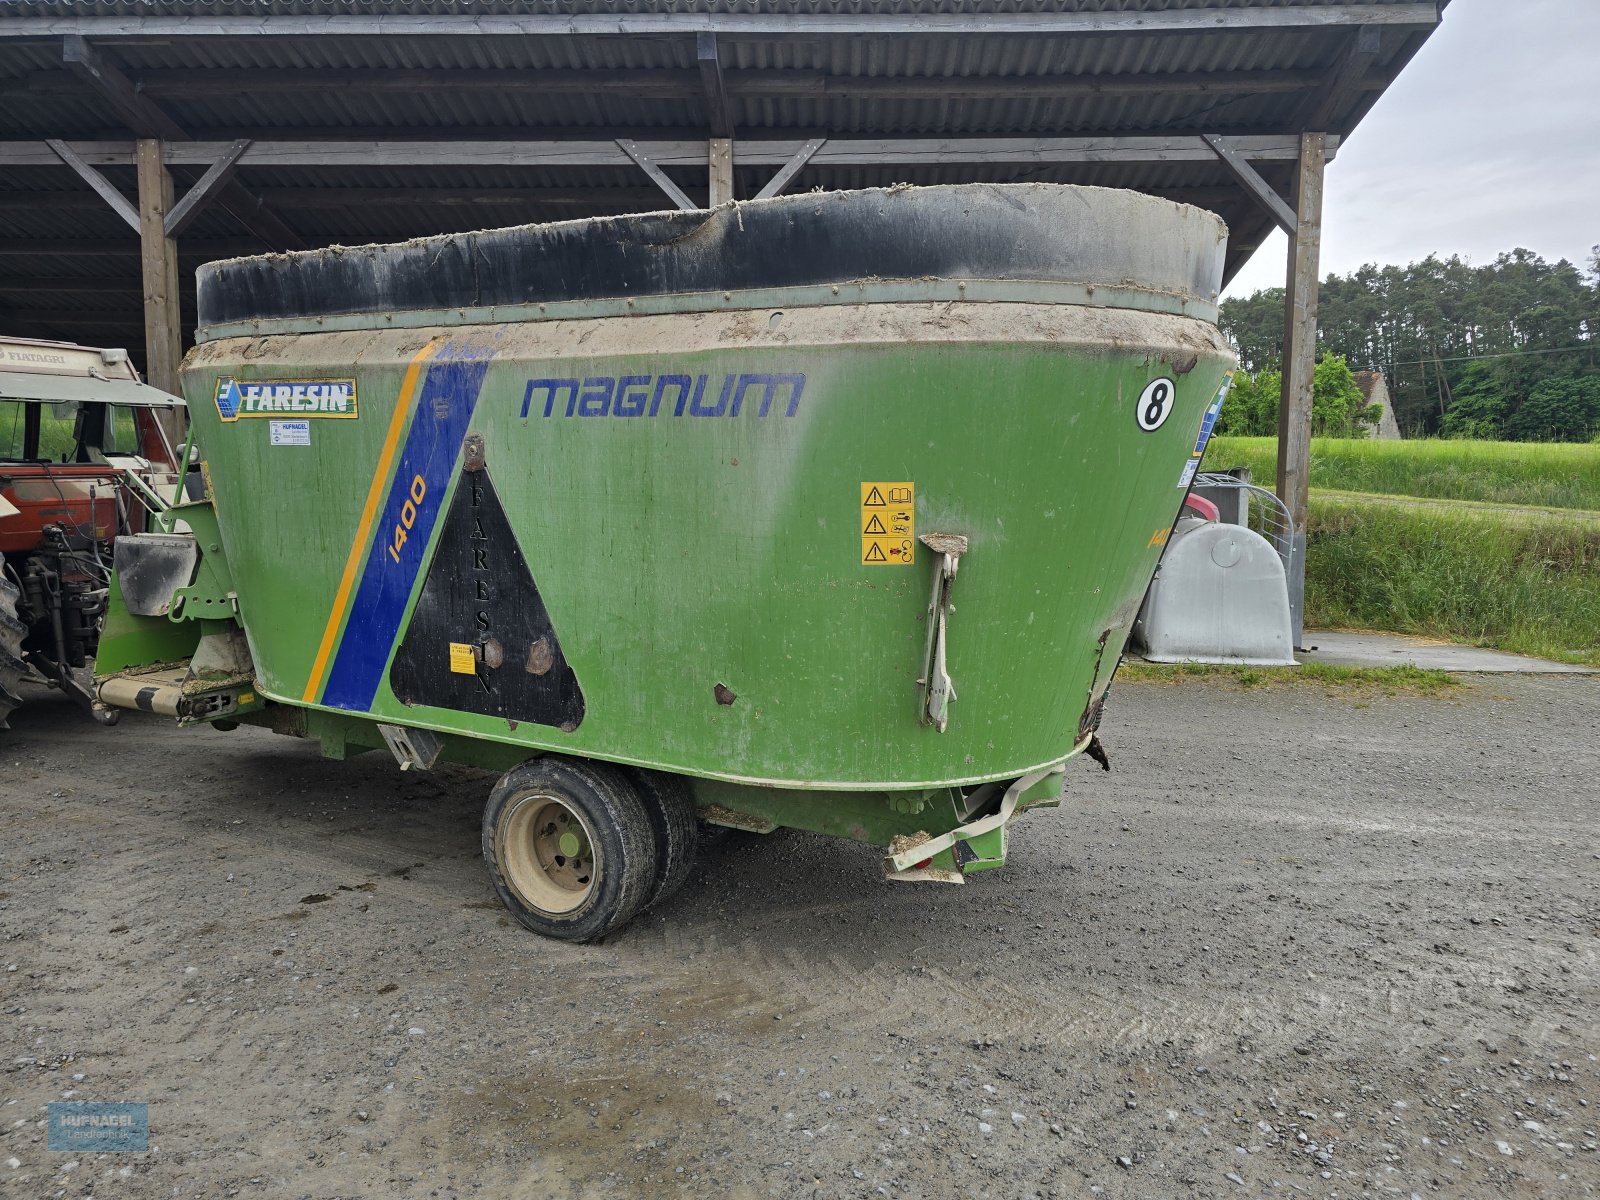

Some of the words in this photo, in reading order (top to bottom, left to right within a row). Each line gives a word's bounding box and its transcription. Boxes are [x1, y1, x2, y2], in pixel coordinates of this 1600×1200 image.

[8, 351, 65, 364] FIATAGRI
[246, 384, 348, 411] FARESIN
[1144, 383, 1168, 425] 8
[388, 474, 426, 564] 1400
[470, 486, 492, 695] FARESIN
